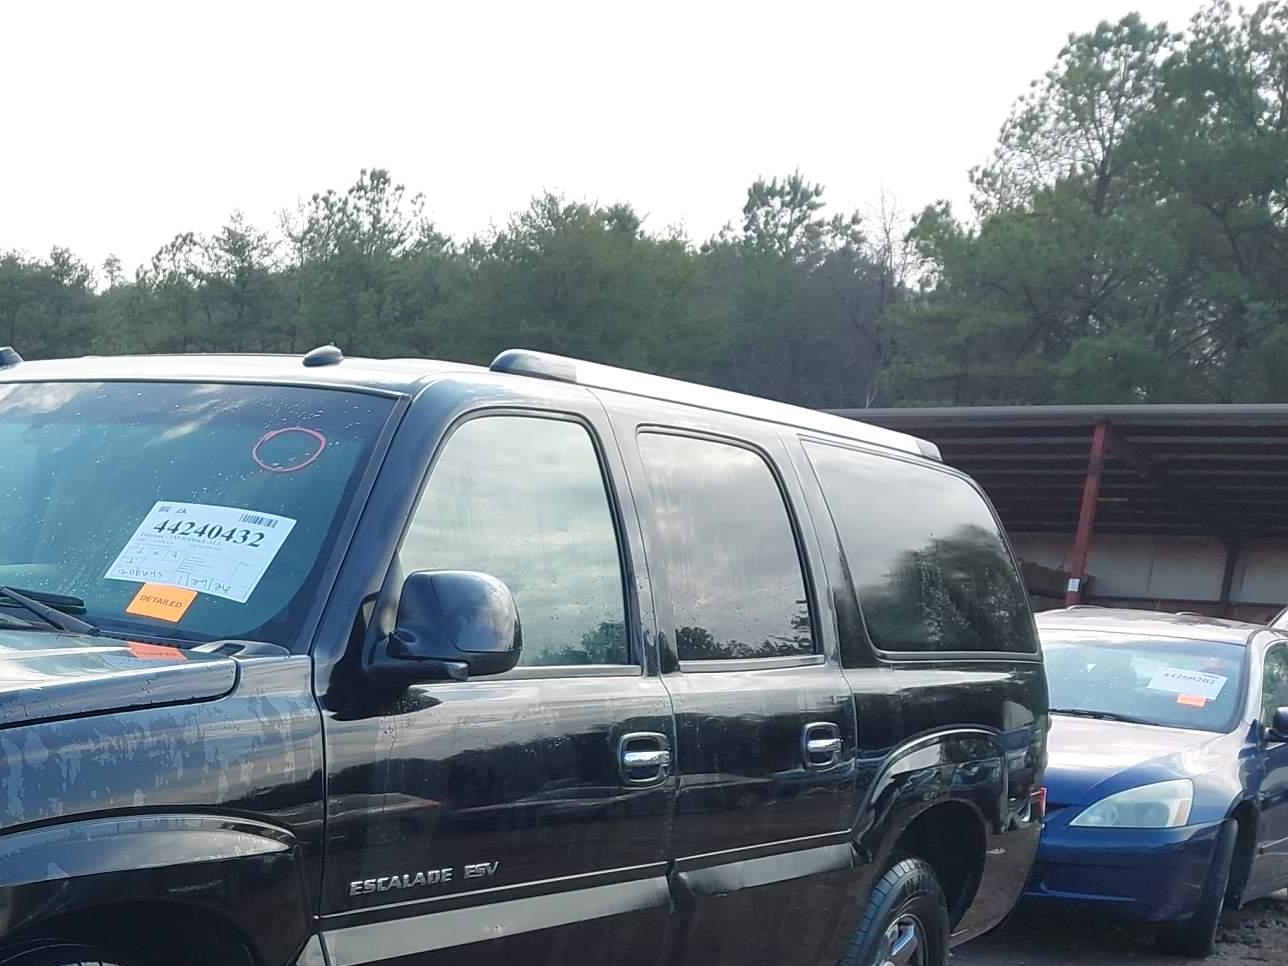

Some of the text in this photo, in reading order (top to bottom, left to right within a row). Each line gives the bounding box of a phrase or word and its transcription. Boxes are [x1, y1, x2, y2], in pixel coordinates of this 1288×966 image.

[153, 519, 265, 548] 44240432
[139, 594, 184, 609] DETAILED
[349, 861, 500, 896] ESCALADE ESV
